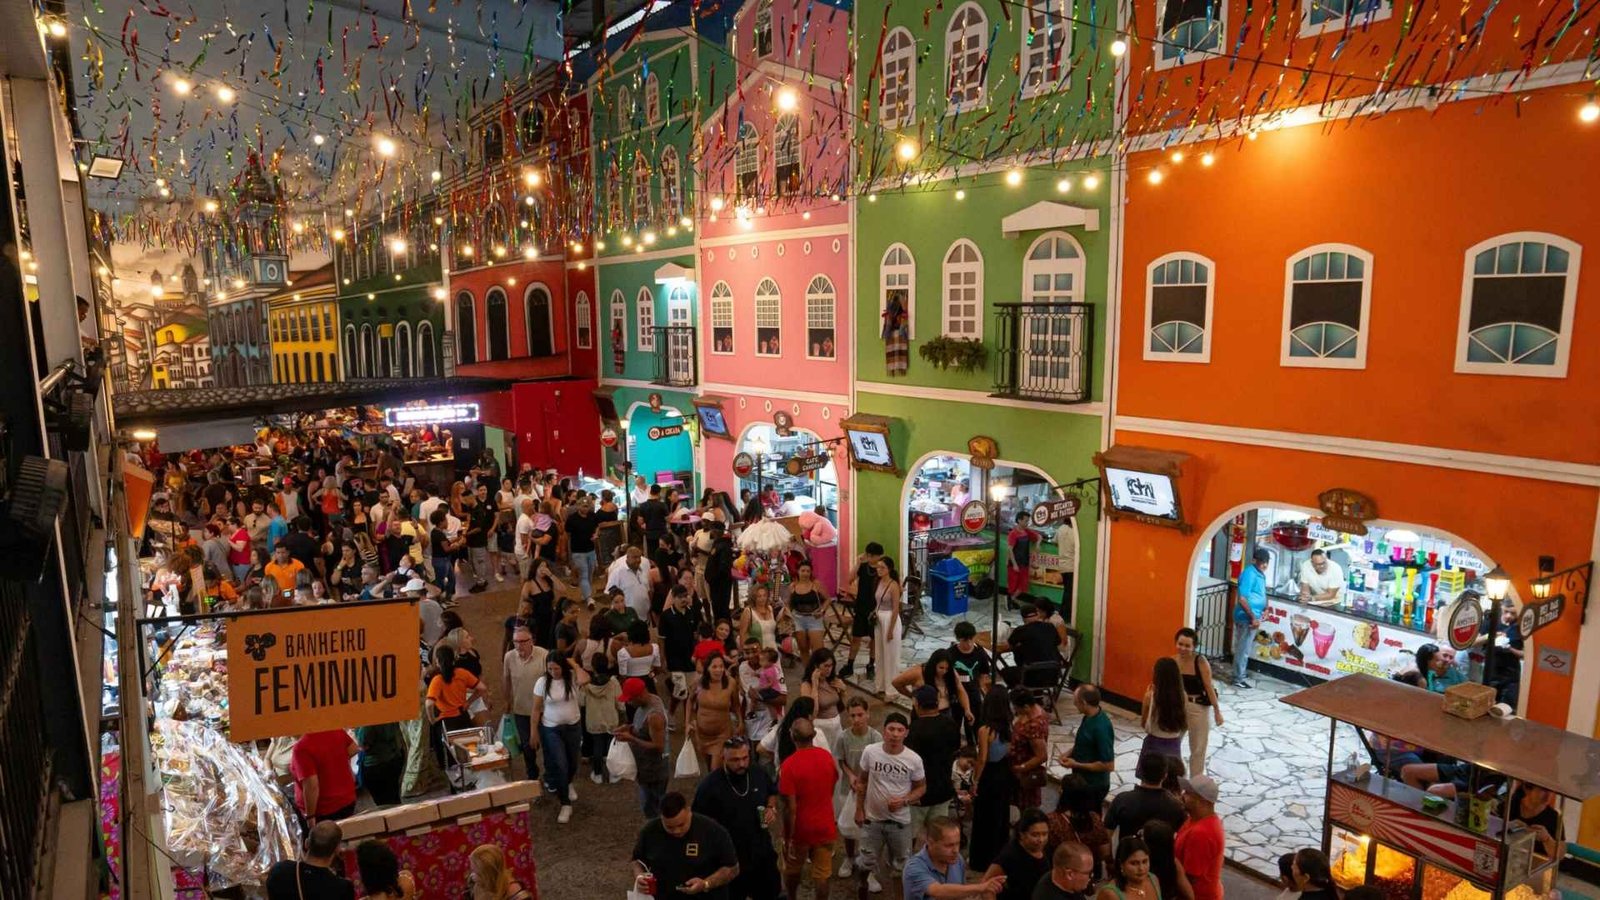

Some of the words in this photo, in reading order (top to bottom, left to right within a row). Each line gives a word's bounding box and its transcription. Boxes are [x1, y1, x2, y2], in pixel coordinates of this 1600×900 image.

[285, 628, 366, 658] BANHEIRO
[254, 653, 397, 715] FEMININO
[874, 761, 908, 775] BOSS
